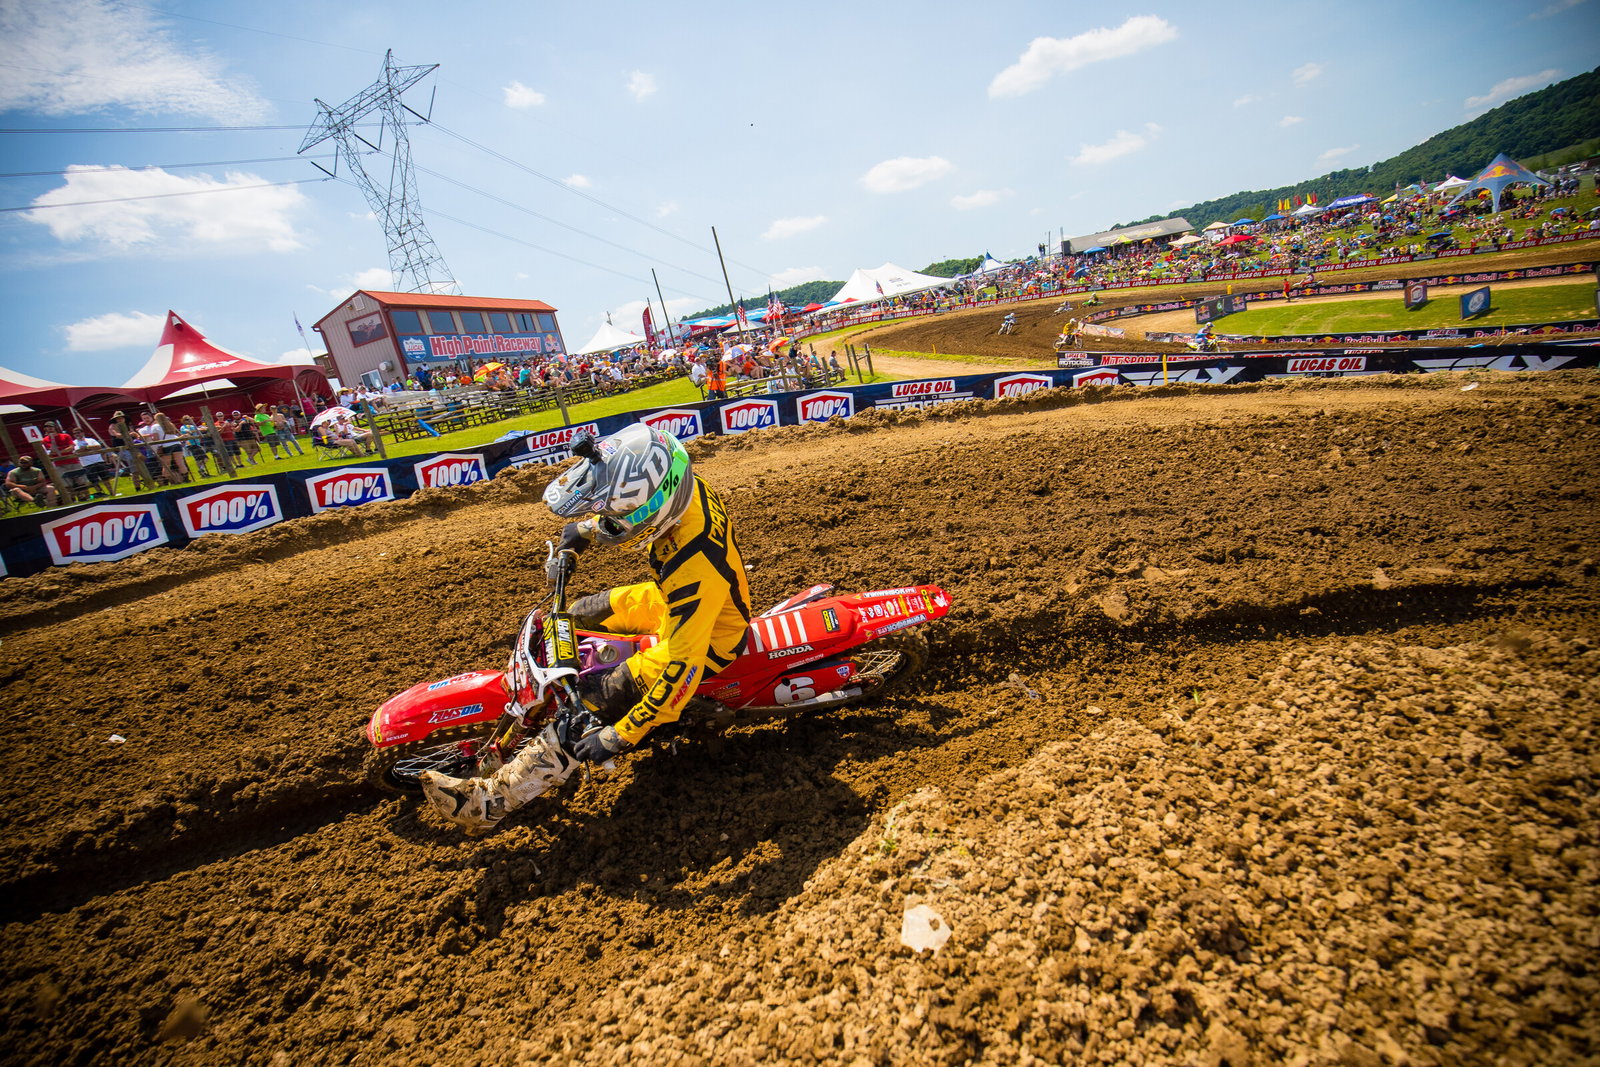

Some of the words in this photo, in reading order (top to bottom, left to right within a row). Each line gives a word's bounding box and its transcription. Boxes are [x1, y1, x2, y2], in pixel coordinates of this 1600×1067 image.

[1578, 231, 1600, 239] LUCA
[1501, 242, 1524, 250] LUCAS
[429, 335, 462, 359] High
[462, 335, 495, 354] Point
[494, 335, 541, 353] Raceway
[1290, 358, 1335, 372] LUCAS
[1339, 357, 1363, 370] OIL
[895, 382, 932, 396] LUCAS
[934, 381, 953, 393] OIL
[729, 406, 772, 426] 100%
[804, 398, 847, 418] 100%
[30, 429, 39, 439] 4
[532, 429, 573, 449] LUCAS
[428, 459, 478, 488] 100%
[321, 474, 382, 506] 100%
[197, 492, 269, 529] 100%
[557, 492, 583, 515] GARMIN
[64, 513, 150, 554] 100%
[619, 525, 657, 549] GEICO
[768, 644, 815, 660] HONDA
[773, 676, 816, 705] 6
[428, 703, 483, 724] AMSOIL
